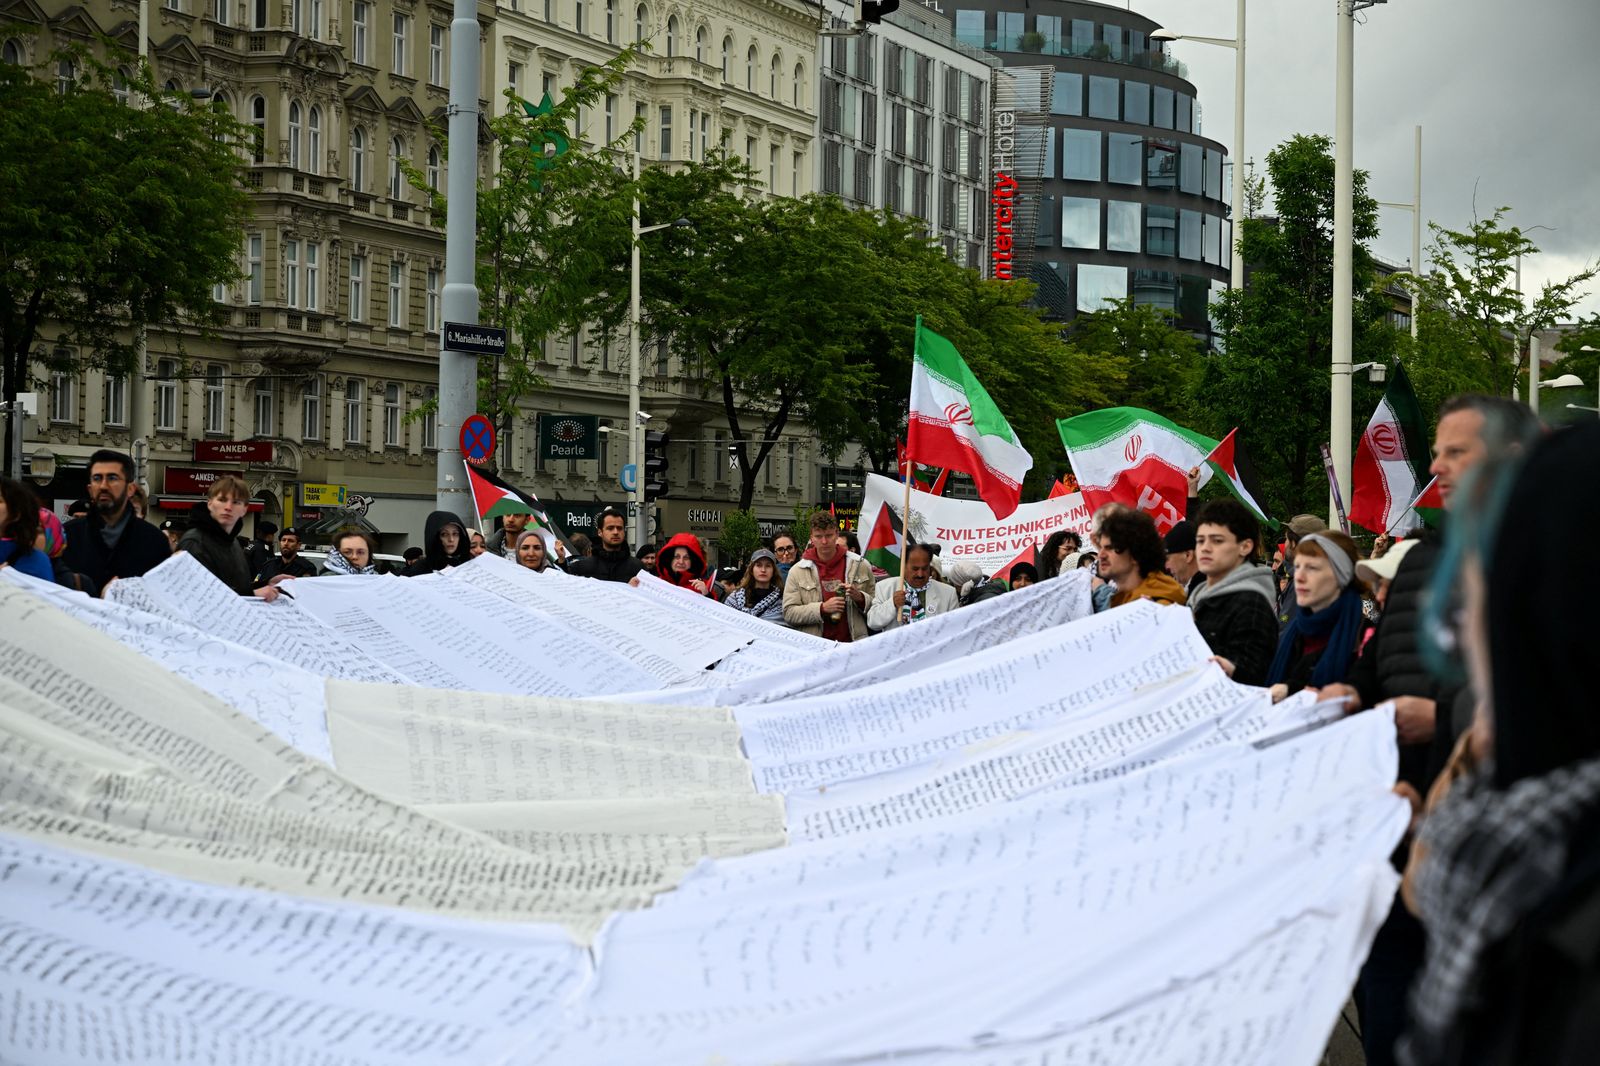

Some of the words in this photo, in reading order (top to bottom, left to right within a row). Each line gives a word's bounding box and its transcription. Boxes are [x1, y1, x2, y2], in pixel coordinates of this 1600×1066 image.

[992, 108, 1018, 280] ntercityHotel
[455, 332, 487, 345] Mariahilfer
[487, 336, 505, 347] Straße
[219, 445, 247, 453] ANKER
[550, 445, 585, 456] Pearle
[195, 473, 215, 482] ANKER
[567, 512, 592, 527] Pearle
[687, 509, 722, 523] SHODAI
[936, 503, 1090, 541] ZIVILTECHNIKERINN
[952, 540, 1007, 555] GEGEN
